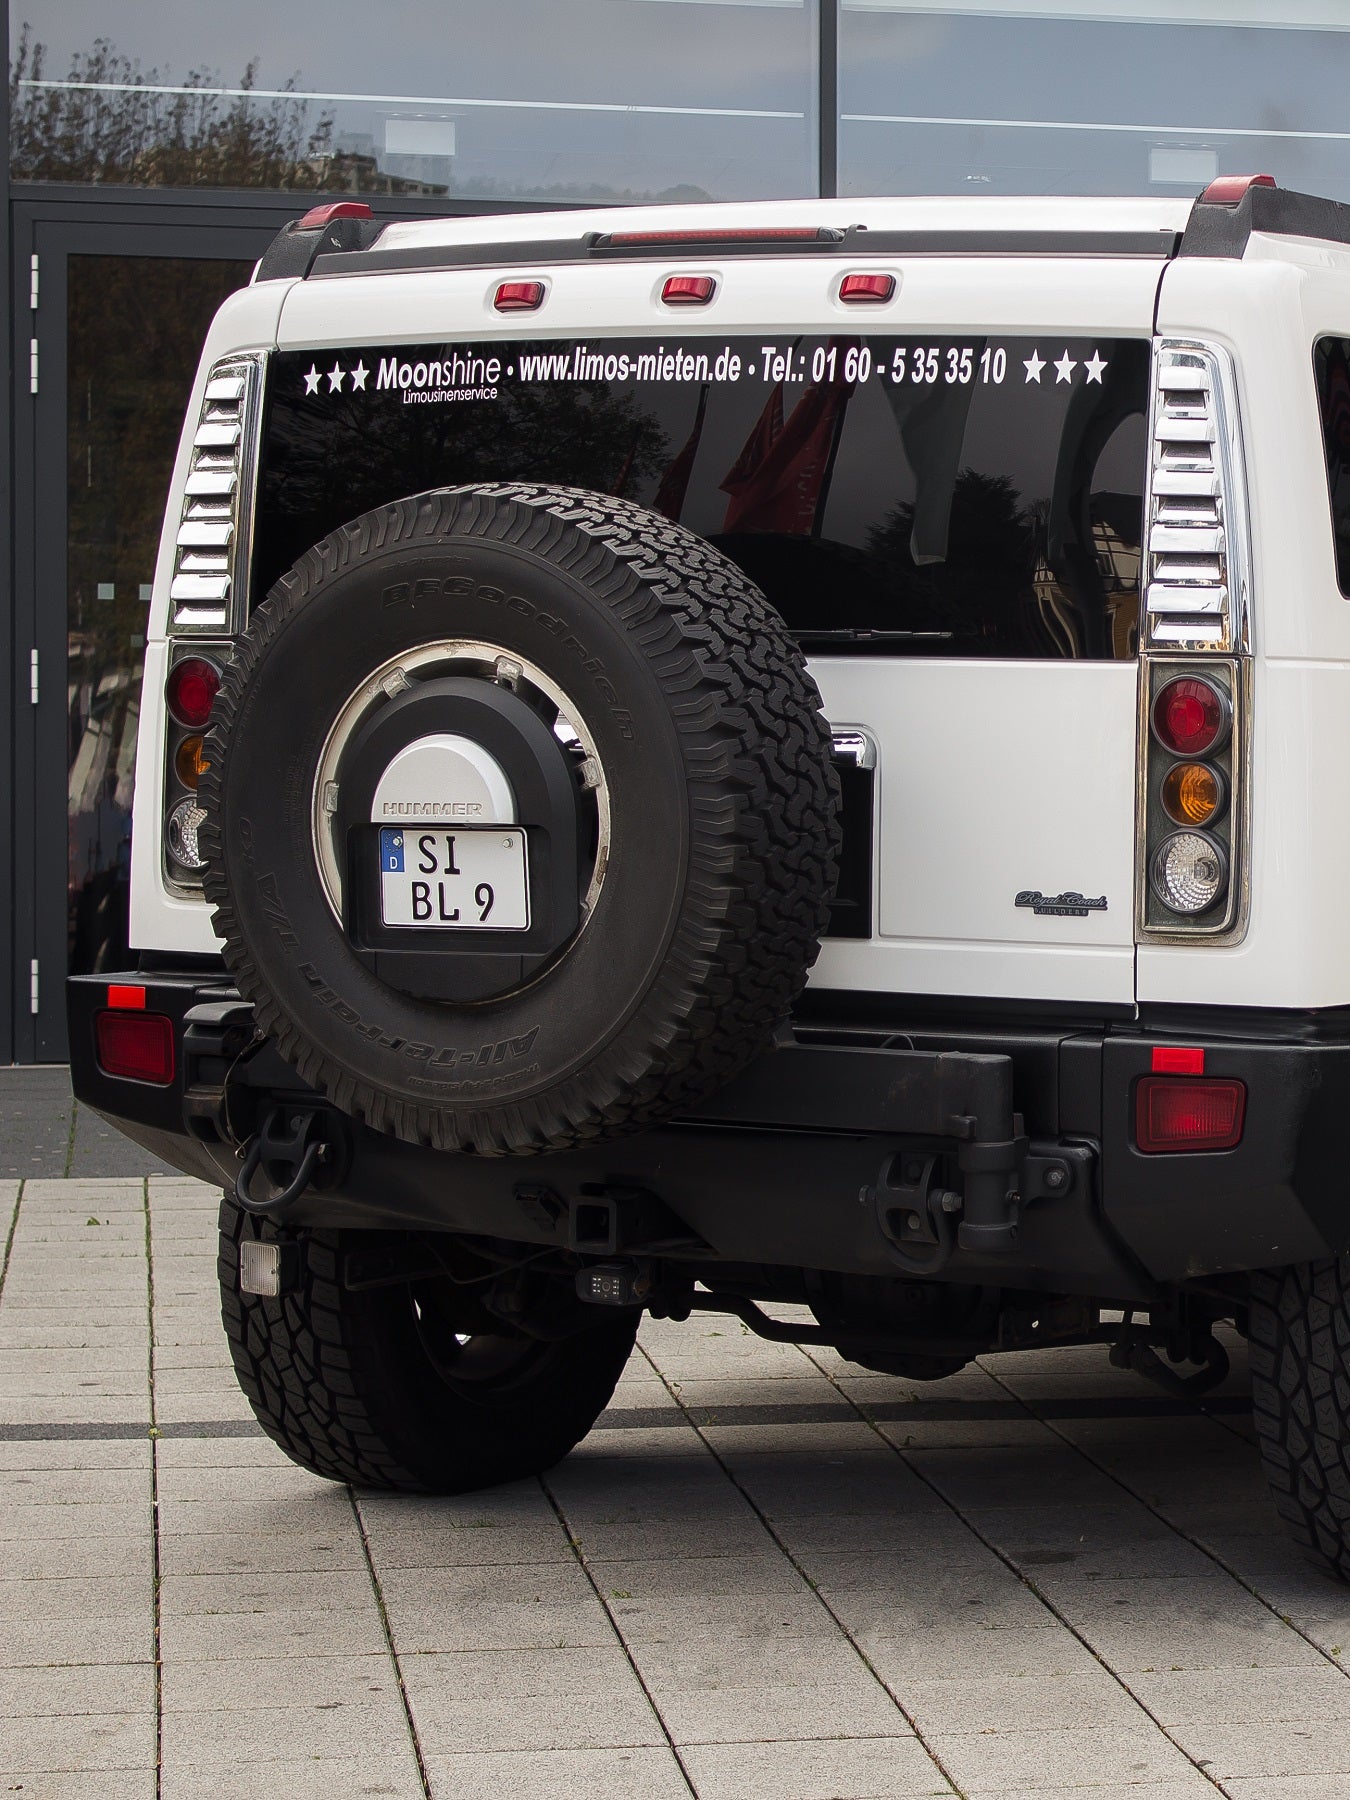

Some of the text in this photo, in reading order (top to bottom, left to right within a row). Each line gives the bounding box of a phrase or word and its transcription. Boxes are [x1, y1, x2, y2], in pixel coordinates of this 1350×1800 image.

[377, 351, 500, 390] Moonshine
[520, 346, 740, 382] www.limos-mieten.de
[762, 346, 806, 382] Tel.:
[812, 347, 837, 382] 01
[844, 348, 871, 382] 60
[891, 348, 906, 382] 5
[911, 348, 939, 383] 35
[945, 348, 973, 383] 35
[979, 348, 1008, 384] 10
[403, 387, 498, 404] Limousinenservice
[382, 802, 482, 816] HUMMER
[389, 857, 398, 870] D
[418, 835, 461, 875] SI
[411, 881, 495, 922] BL 9
[1015, 891, 1107, 908] Royal Coach
